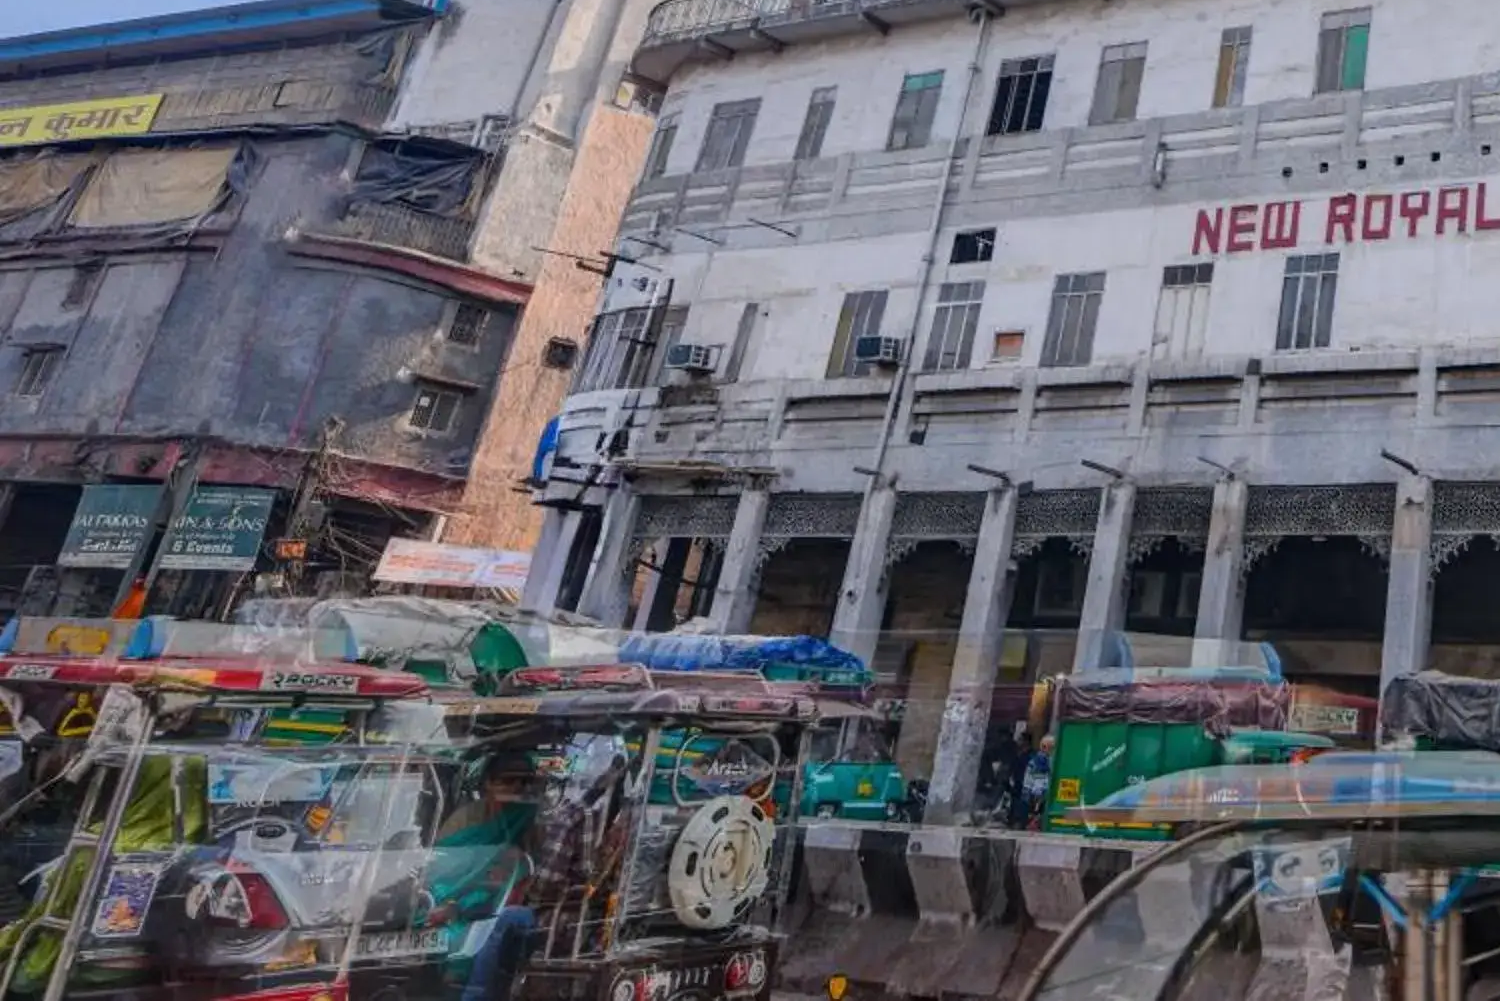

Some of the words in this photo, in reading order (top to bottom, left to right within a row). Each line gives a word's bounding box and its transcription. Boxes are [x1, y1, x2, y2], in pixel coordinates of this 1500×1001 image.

[44, 103, 149, 139] कुमार
[1191, 200, 1301, 256] NEW
[186, 540, 233, 554] Events
